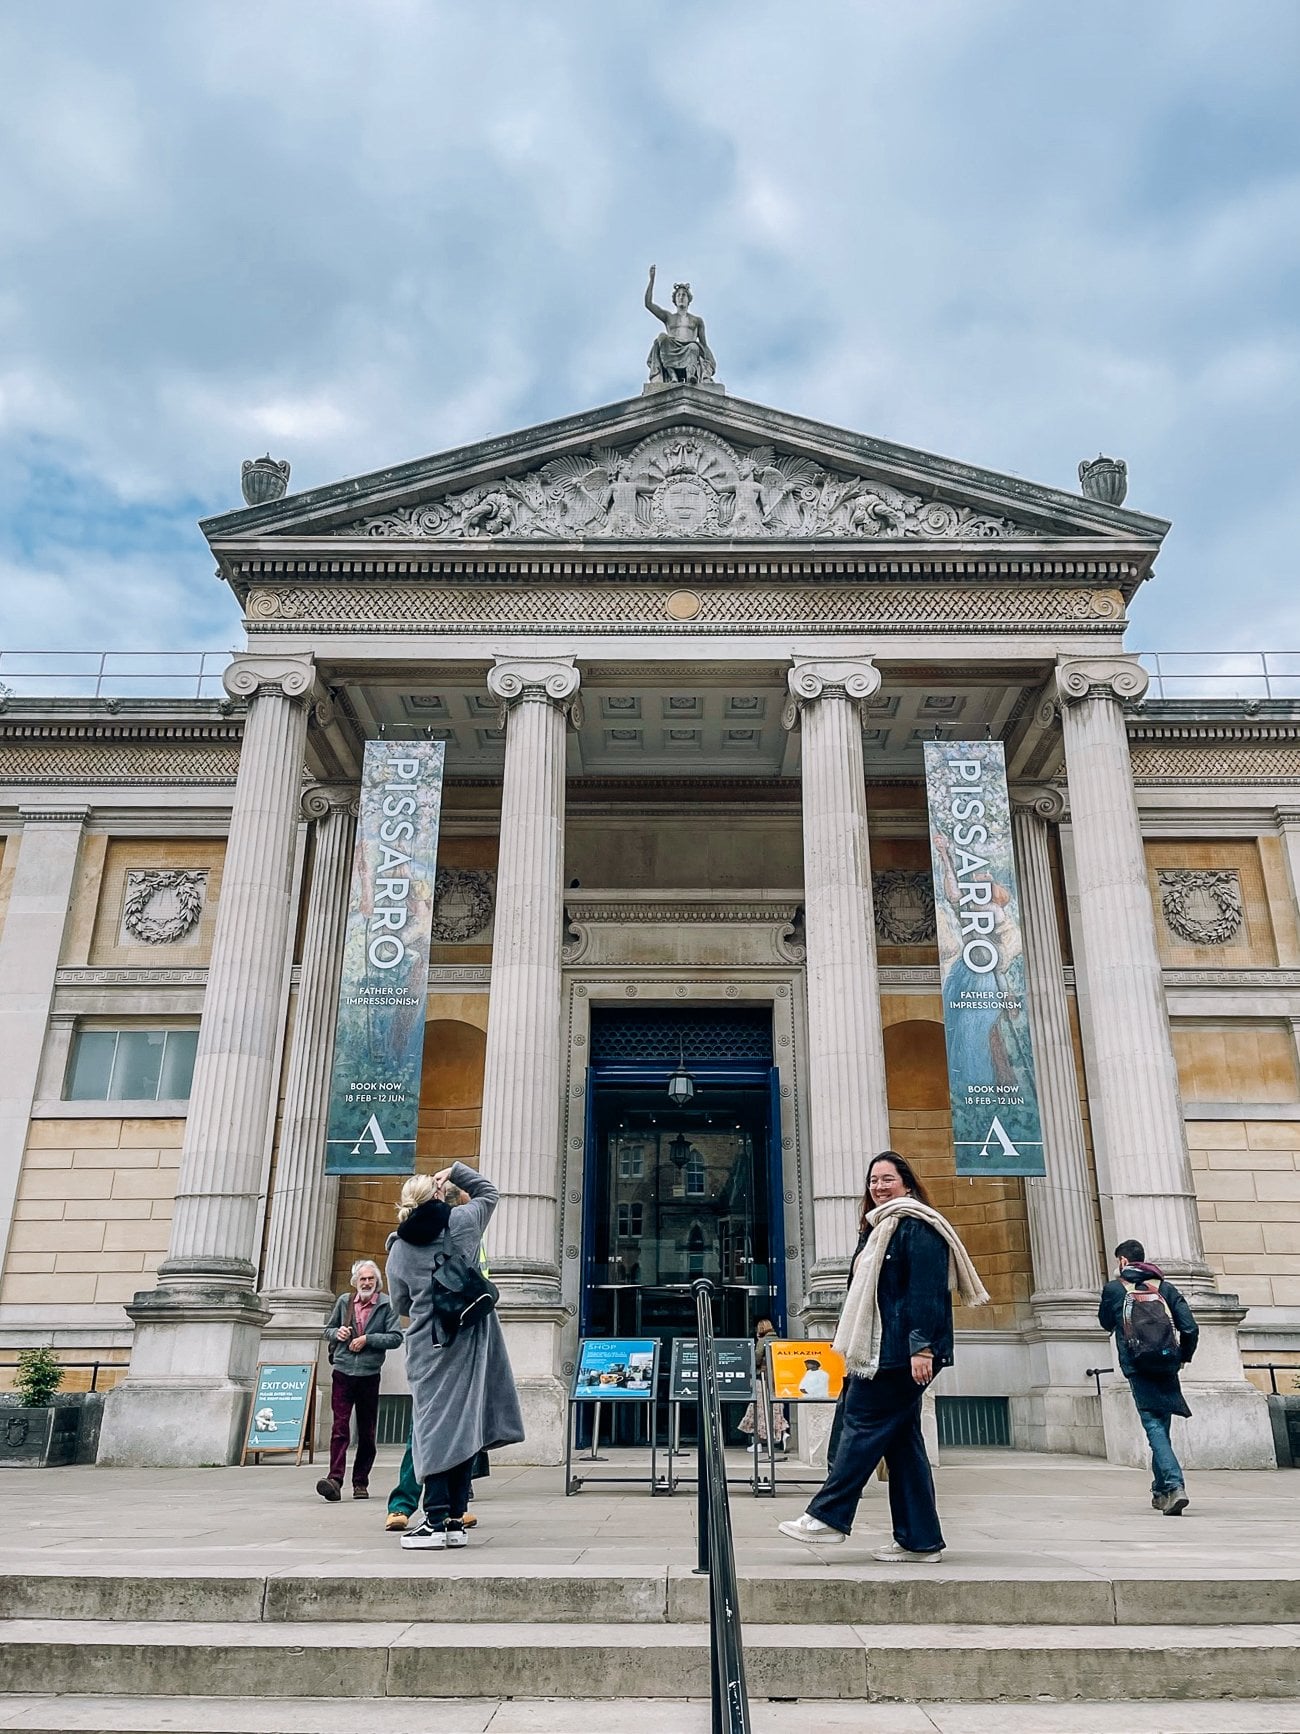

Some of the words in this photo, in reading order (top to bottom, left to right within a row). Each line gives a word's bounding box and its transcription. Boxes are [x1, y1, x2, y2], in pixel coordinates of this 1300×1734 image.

[368, 758, 419, 969] PISSARRO
[948, 760, 999, 974] PISSARRO
[359, 987, 394, 995] FATHER
[395, 987, 409, 995] OF
[960, 991, 994, 999] FATHER
[996, 991, 1009, 999] OF
[346, 997, 419, 1006] IMPRESSIONISM
[950, 1001, 1022, 1009] IMPRESSIONISM
[350, 1082, 377, 1091] BOOK
[379, 1082, 402, 1091] NOW
[968, 1085, 994, 1093] BOOK
[996, 1085, 1019, 1093] NOW
[345, 1094, 354, 1103] 18
[355, 1094, 372, 1103] FEB
[378, 1094, 388, 1103] 12
[388, 1094, 405, 1103] JUN
[964, 1096, 974, 1105] 18
[975, 1096, 991, 1105] FEB
[998, 1096, 1007, 1105] 12
[1007, 1096, 1025, 1105] JUN
[261, 1381, 281, 1390] EXIT
[281, 1381, 306, 1390] ONLY
